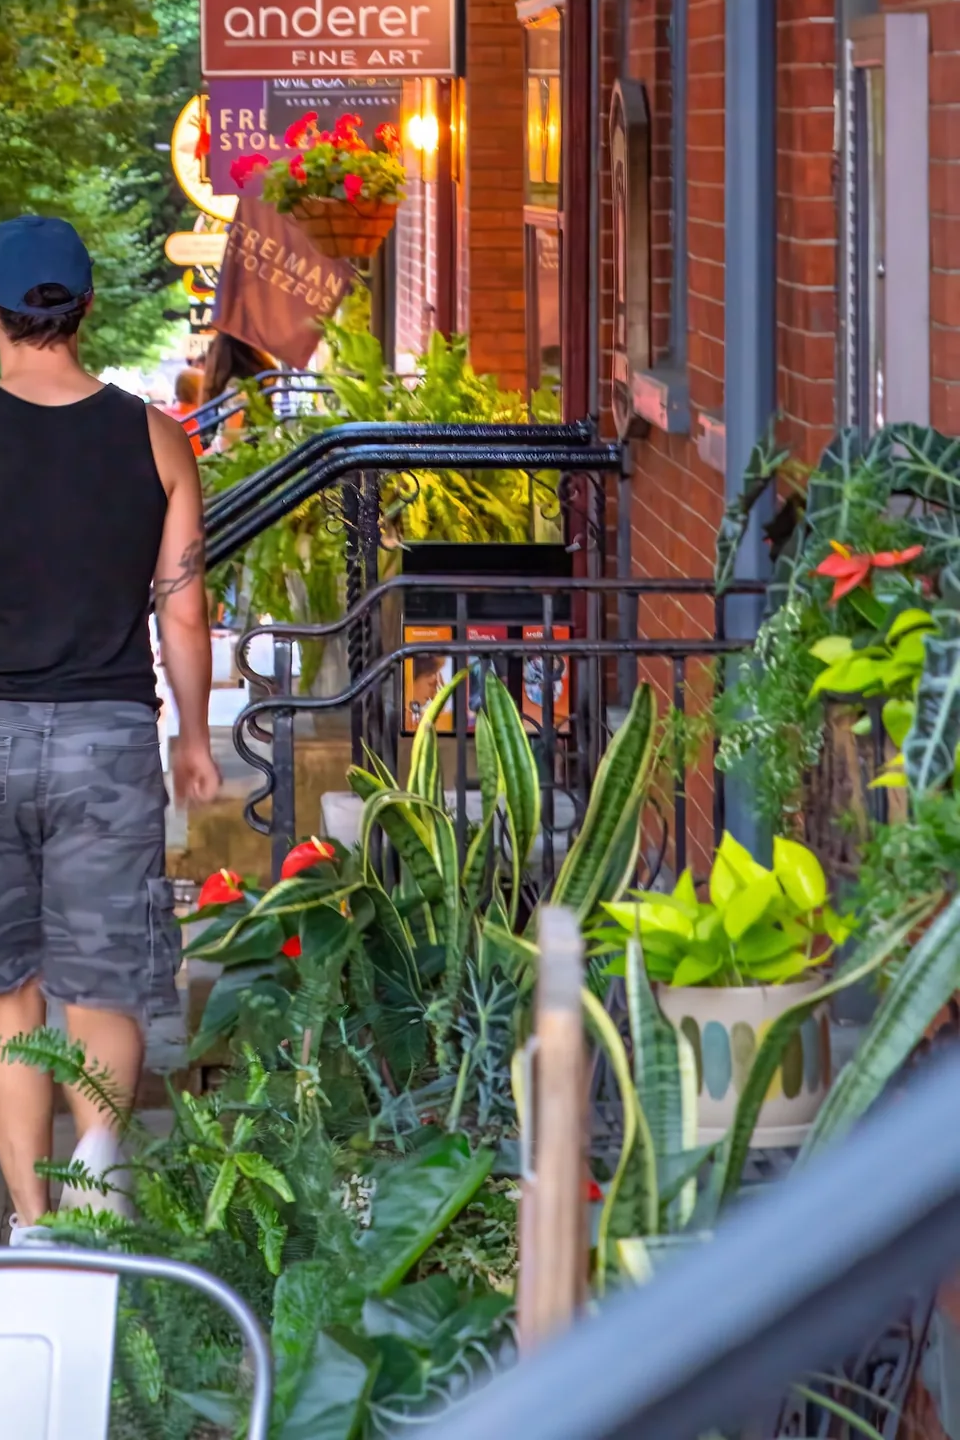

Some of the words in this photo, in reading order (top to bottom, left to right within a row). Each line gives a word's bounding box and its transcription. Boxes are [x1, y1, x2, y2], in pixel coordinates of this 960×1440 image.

[292, 49, 358, 66] FINE
[367, 49, 424, 66] ART
[230, 221, 343, 298] FREIMAN
